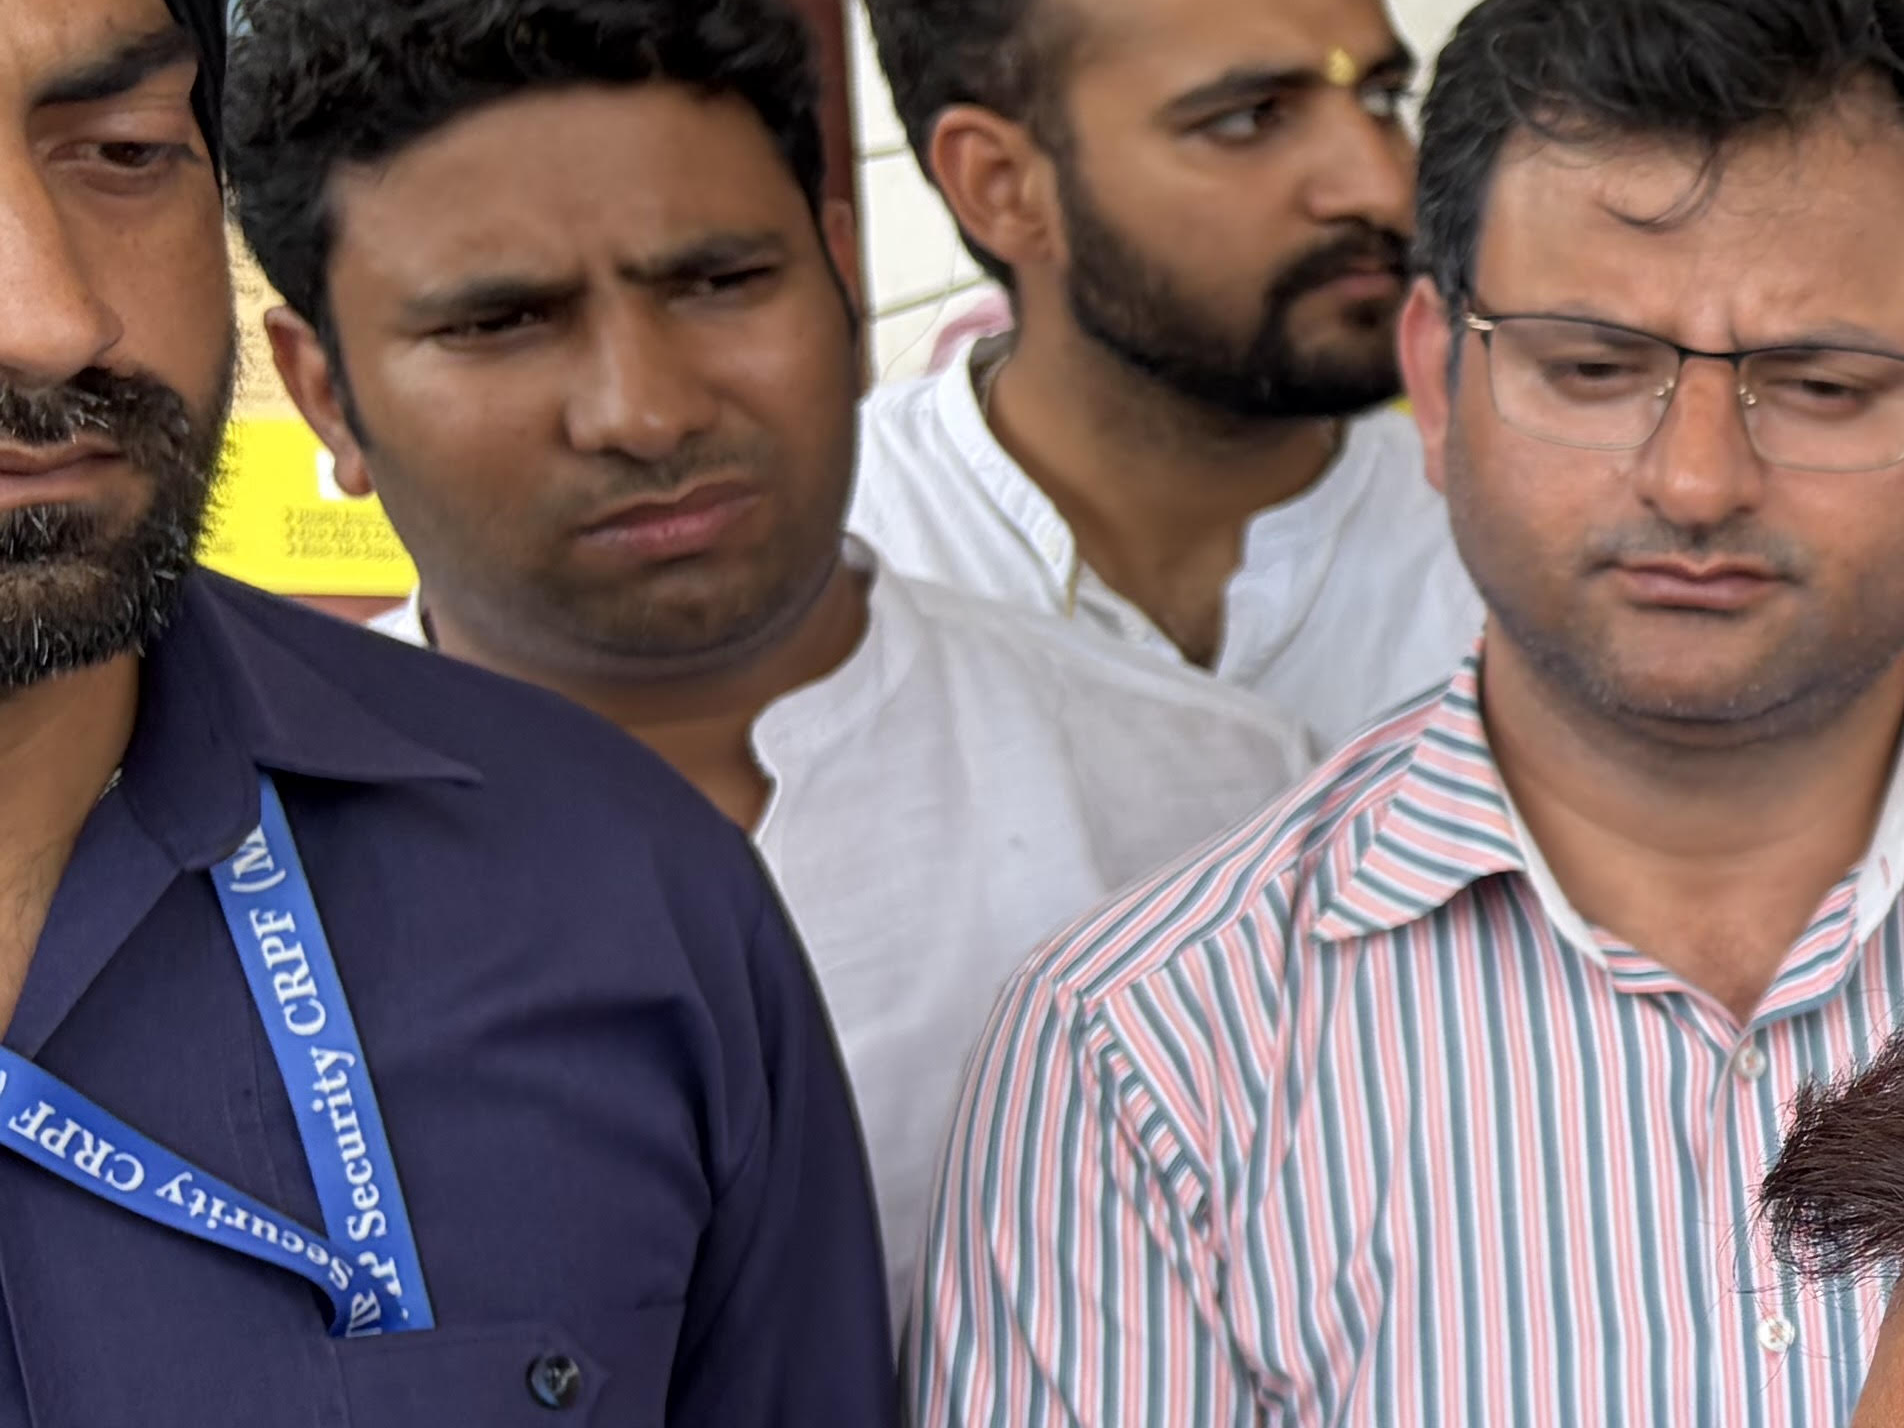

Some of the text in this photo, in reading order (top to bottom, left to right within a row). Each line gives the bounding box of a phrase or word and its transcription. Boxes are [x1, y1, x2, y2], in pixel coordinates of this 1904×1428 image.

[249, 908, 326, 1037] CRPF
[7, 1100, 146, 1193] CRPF
[310, 1046, 388, 1240] Security
[156, 1170, 355, 1291] Security
